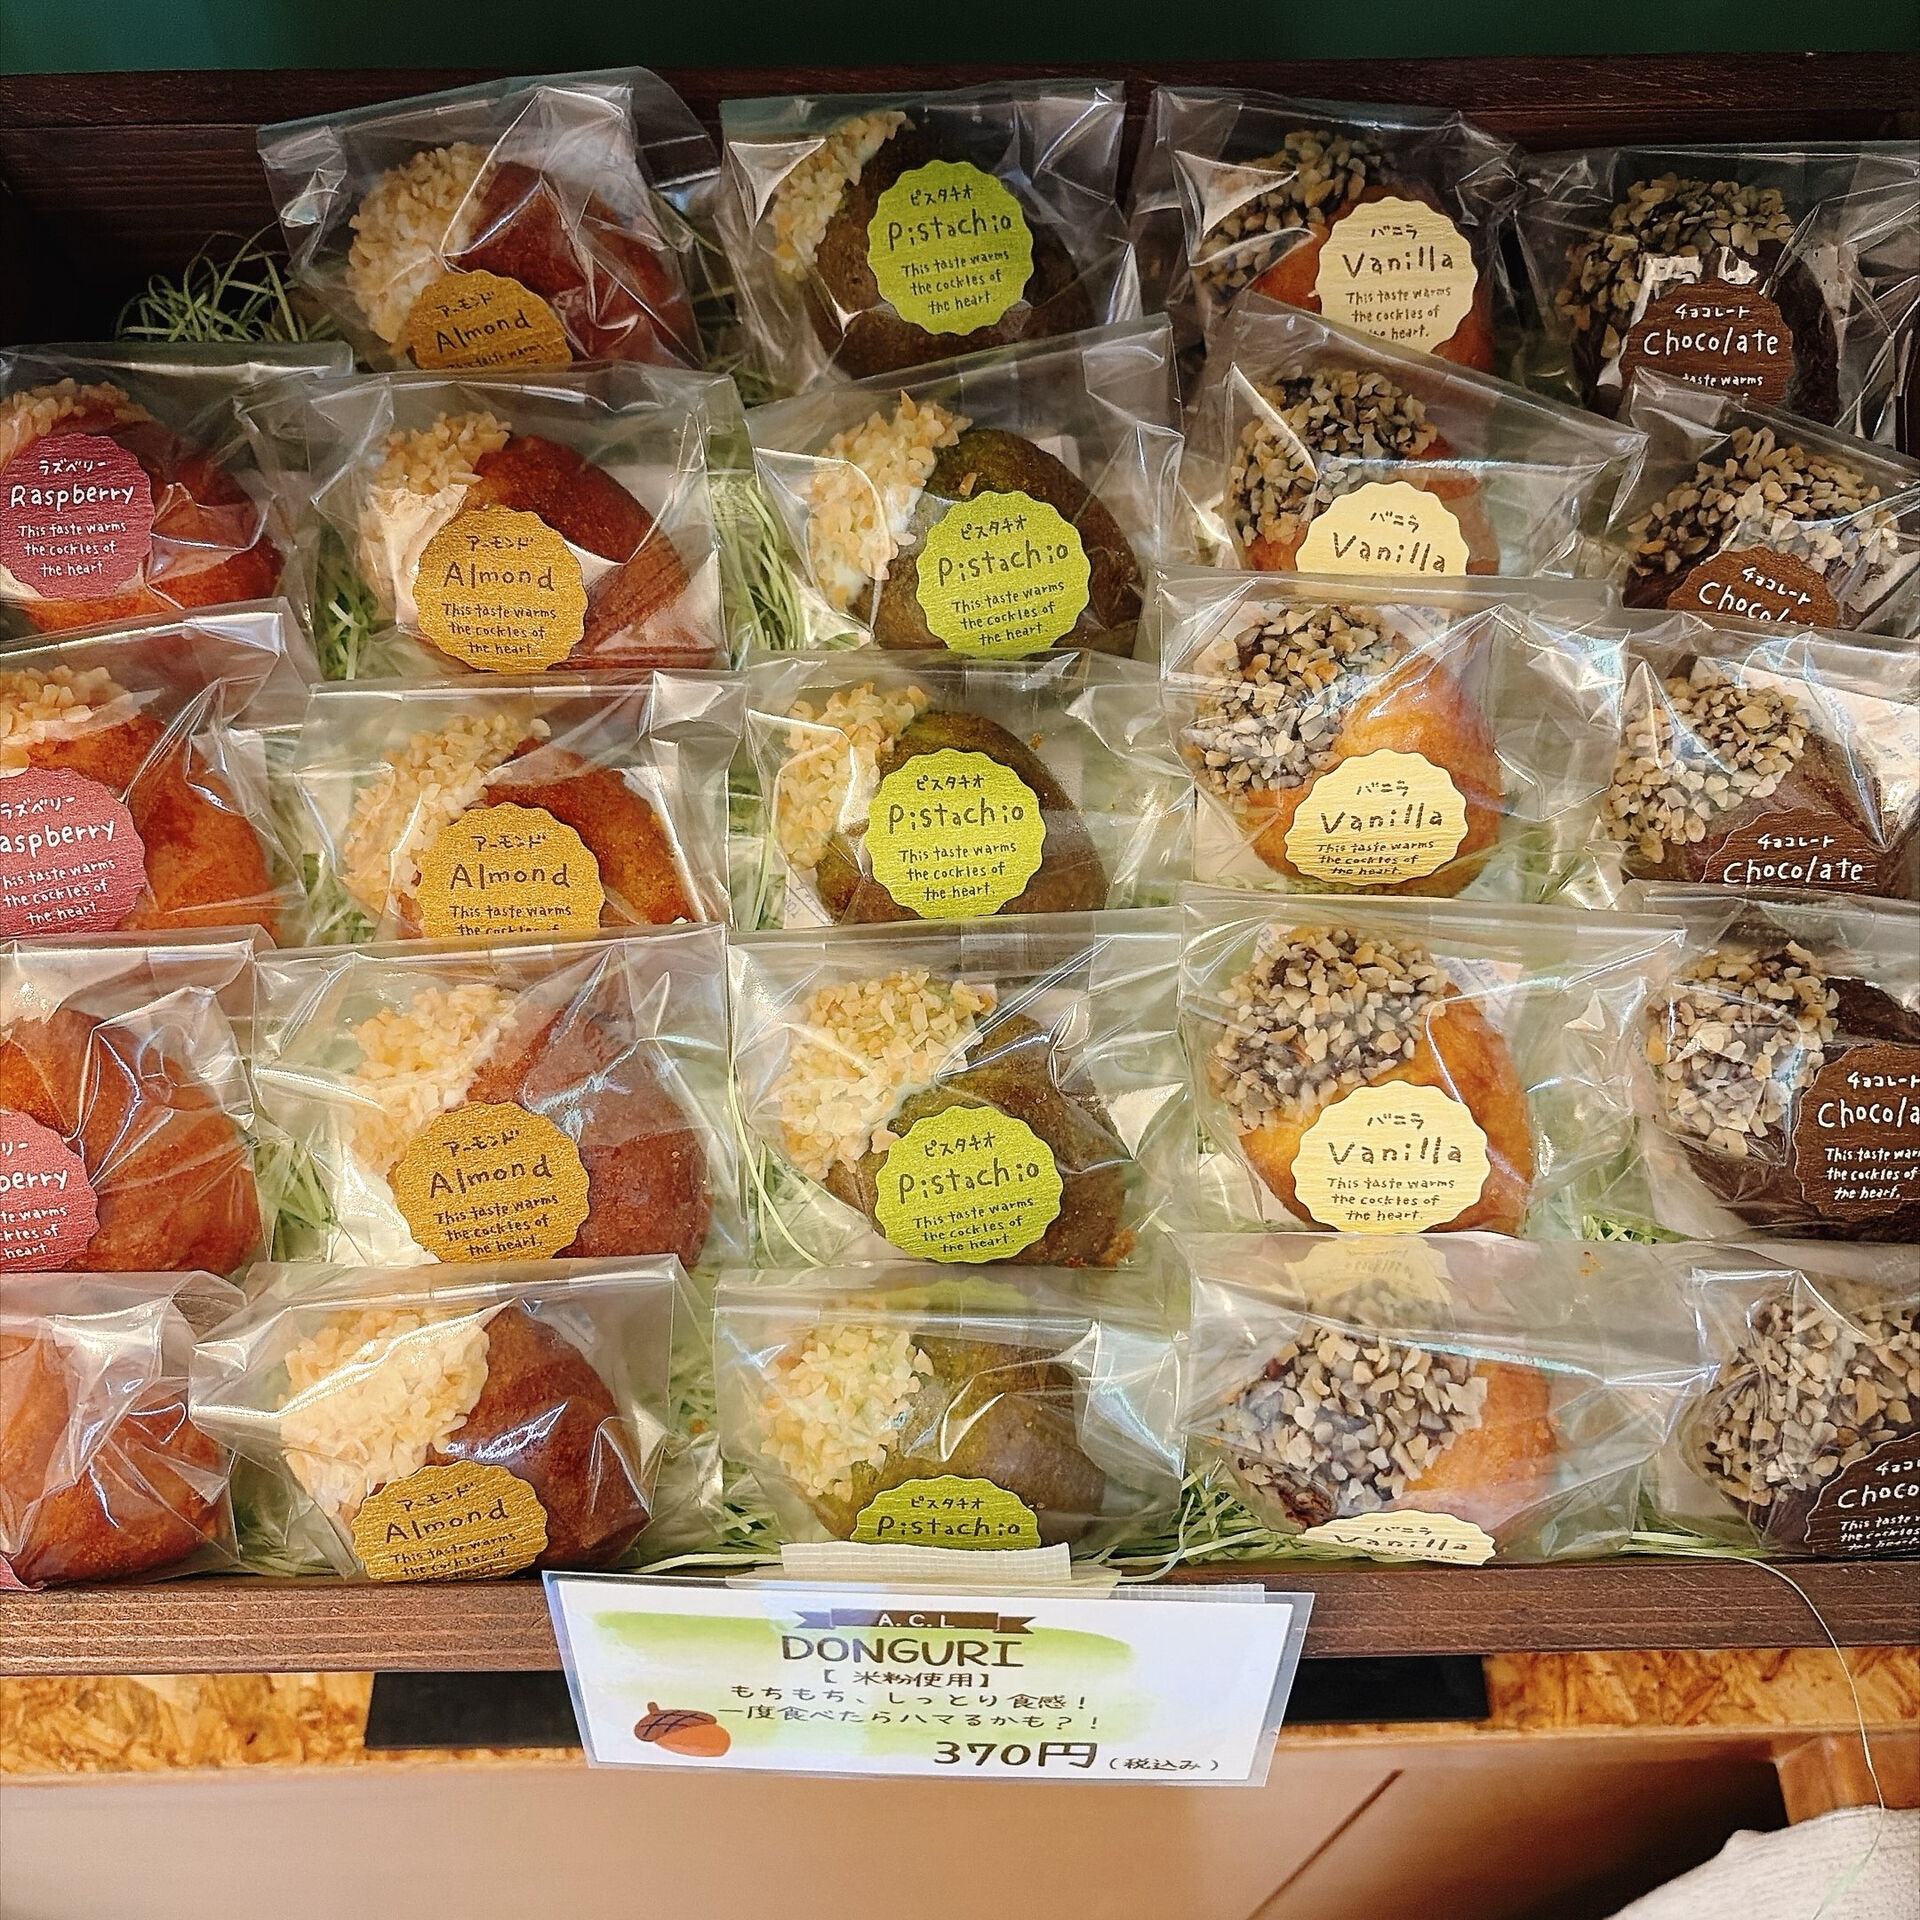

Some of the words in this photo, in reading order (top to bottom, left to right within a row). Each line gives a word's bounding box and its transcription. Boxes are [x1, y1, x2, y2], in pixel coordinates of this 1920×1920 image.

[910, 184, 973, 206] ピスタチオ
[888, 208, 1012, 251] Pistachio
[1371, 224, 1418, 239] バニラ
[901, 263, 930, 278] This
[934, 256, 966, 272] taste
[969, 251, 1009, 264] warms
[1342, 246, 1453, 279] Vanilla
[910, 282, 932, 296] the
[936, 275, 985, 292] cockles
[990, 269, 1002, 283] of
[1345, 292, 1373, 305] This
[1377, 289, 1409, 303] taste
[1412, 287, 1451, 300] warms
[929, 300, 950, 314] the
[1351, 310, 1372, 322] the
[1376, 307, 1423, 322] cockles
[1427, 305, 1440, 319] of
[1674, 303, 1751, 320] チョコレート
[436, 309, 532, 353] Almond
[1643, 326, 1779, 356] Chocolate
[1721, 376, 1764, 387] warms
[39, 458, 107, 476] ラズベリー
[10, 483, 134, 512] Raspberry
[18, 524, 46, 538] This
[50, 523, 82, 538] taste
[86, 522, 127, 535] warms
[961, 514, 1027, 540] ピスタチオ
[1369, 510, 1419, 533] バニラ
[24, 543, 45, 556] the
[49, 543, 99, 556] cockles
[103, 540, 116, 554] of
[1332, 532, 1446, 573] Vanilla
[40, 562, 62, 577] the
[938, 540, 1069, 587] Pistachio
[443, 561, 555, 592] Almond
[1741, 566, 1812, 605] チョコレート
[952, 599, 981, 614] This
[984, 591, 1019, 609] taste
[1022, 581, 1065, 598] warms
[441, 603, 471, 617] This
[475, 604, 510, 619] taste
[514, 607, 557, 619] warms
[961, 616, 983, 630] the
[987, 608, 1037, 626] cockles
[1043, 601, 1056, 615] of
[450, 622, 471, 635] the
[476, 625, 527, 638] cockles
[532, 626, 546, 639] of
[979, 632, 1001, 646] the
[468, 642, 489, 655] the
[916, 774, 984, 791] ピスタチオ
[1356, 780, 1409, 797] バニラ
[889, 797, 1024, 835] Pistachio
[1320, 802, 1443, 834] Vanilla
[1316, 843, 1346, 854] This
[1350, 842, 1387, 854] taste
[1391, 841, 1434, 850] warms
[1757, 832, 1835, 851] チョコレート
[899, 849, 929, 864] This
[934, 845, 969, 861] taste
[973, 842, 1017, 856] warms
[1318, 855, 1341, 865] the
[1403, 854, 1419, 865] of
[28, 867, 67, 884] taste
[69, 859, 116, 876] warms
[450, 863, 570, 890] Almond
[906, 868, 929, 881] the
[934, 864, 987, 881] cockles
[991, 861, 1006, 876] of
[1723, 855, 1864, 884] Chocolate
[3, 893, 30, 908] the
[32, 886, 90, 905] cockles
[93, 879, 108, 893] of
[923, 887, 946, 901] the
[26, 911, 52, 926] the
[449, 905, 480, 919] This
[485, 905, 522, 919] taste
[527, 906, 572, 917] warms
[1366, 1112, 1424, 1130] バニラ
[924, 1131, 996, 1158] ピスタチオ
[1328, 1136, 1461, 1165] Vanilla
[1824, 1147, 1853, 1162] This
[1857, 1147, 1889, 1162] taste
[430, 1154, 552, 1198] Almond
[899, 1157, 1040, 1204] Pistachio
[1326, 1177, 1359, 1189] This
[1362, 1177, 1402, 1189] taste
[1407, 1179, 1455, 1189] warms
[1826, 1166, 1847, 1180] the
[1850, 1167, 1900, 1181] cockles
[1903, 1166, 1919, 1180] of
[1331, 1193, 1355, 1205] the
[1360, 1194, 1419, 1205] cockles
[1423, 1194, 1441, 1206] of
[1833, 1186, 1857, 1200] the
[20, 1207, 67, 1221] warms
[433, 1210, 466, 1225] This
[470, 1203, 508, 1220] taste
[514, 1194, 559, 1212] warms
[912, 1215, 944, 1229] This
[948, 1207, 985, 1223] taste
[988, 1198, 1034, 1214] warms
[1345, 1210, 1370, 1220] the
[44, 1223, 59, 1237] of
[445, 1229, 469, 1242] the
[474, 1221, 531, 1238] cockles
[535, 1213, 549, 1228] of
[922, 1229, 945, 1241] the
[949, 1221, 1004, 1238] cockles
[1008, 1215, 1024, 1228] of
[466, 1244, 491, 1257] the
[940, 1242, 964, 1253] the
[911, 1495, 985, 1510] ピスタチオ
[386, 1498, 509, 1543] Almond
[877, 1515, 1021, 1537] Pistachio
[1840, 1520, 1870, 1531] This
[1875, 1515, 1911, 1528] taste
[390, 1553, 422, 1565] This
[469, 1533, 516, 1550] warms
[781, 1635, 1024, 1667] DONGURI
